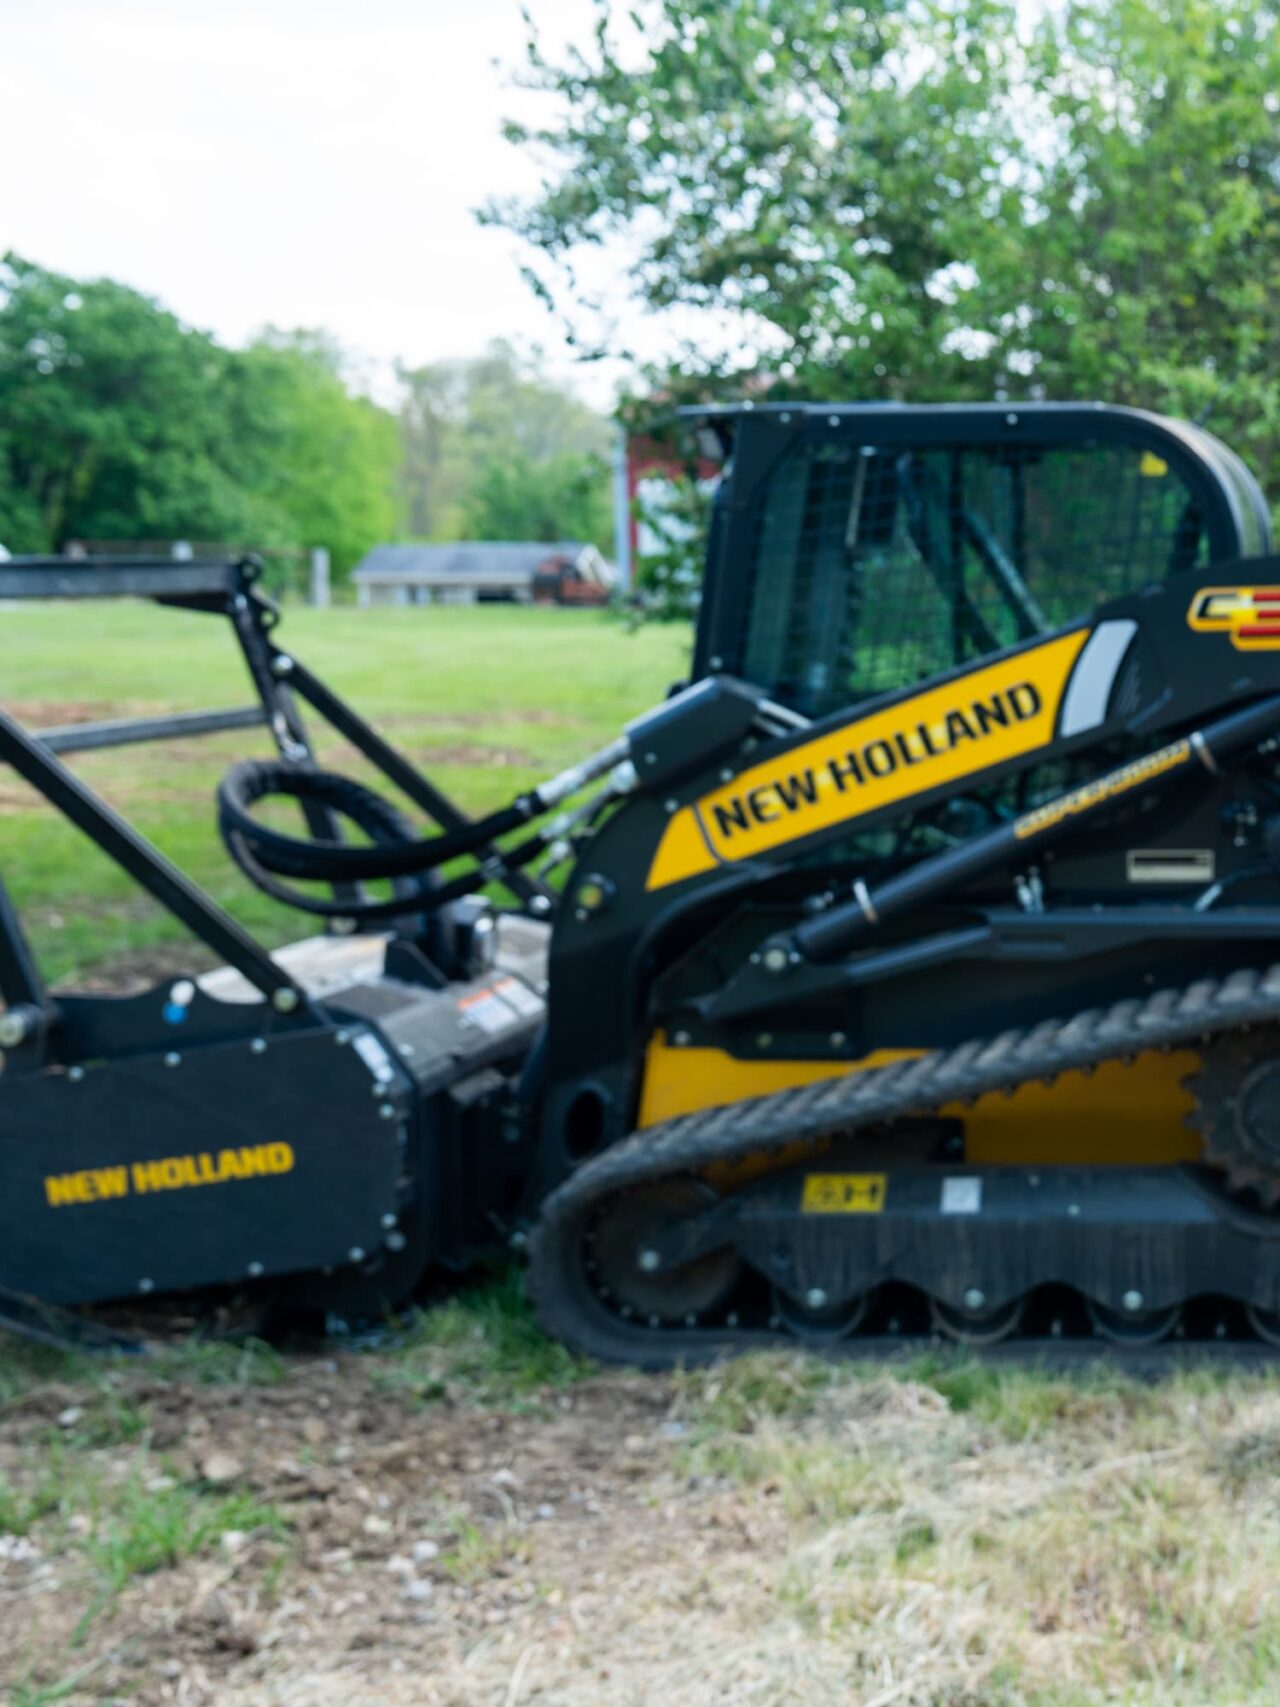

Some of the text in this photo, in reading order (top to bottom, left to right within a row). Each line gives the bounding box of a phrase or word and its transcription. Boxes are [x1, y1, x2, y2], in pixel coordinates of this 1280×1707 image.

[712, 769, 818, 838] NEW
[827, 681, 1044, 793] HOLLAND
[44, 1141, 295, 1207] NEW HOLLAND
